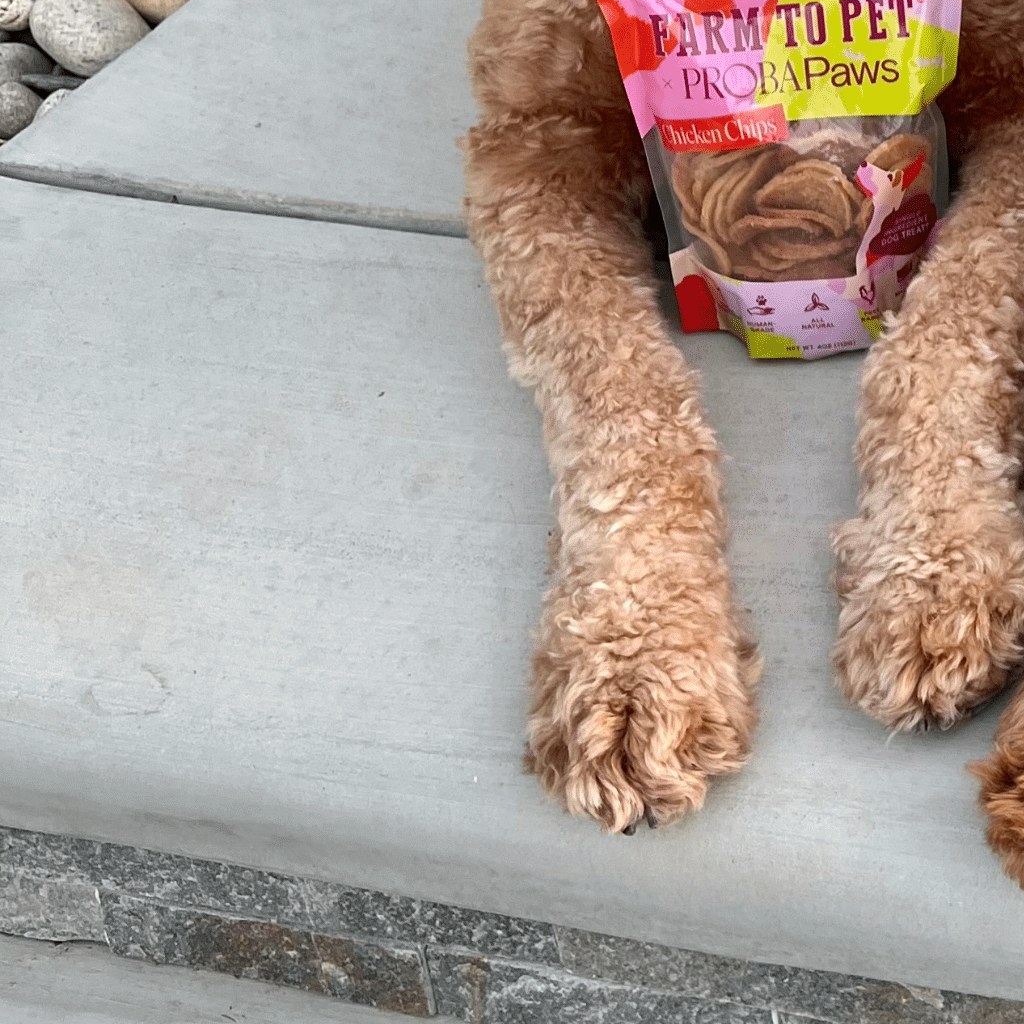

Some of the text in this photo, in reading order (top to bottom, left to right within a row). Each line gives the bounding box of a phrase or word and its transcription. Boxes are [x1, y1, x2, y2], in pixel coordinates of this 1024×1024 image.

[648, 6, 764, 58] FARM
[775, 0, 828, 49] TO
[662, 115, 777, 147] Chicken Chips
[801, 322, 835, 330] NATURAL
